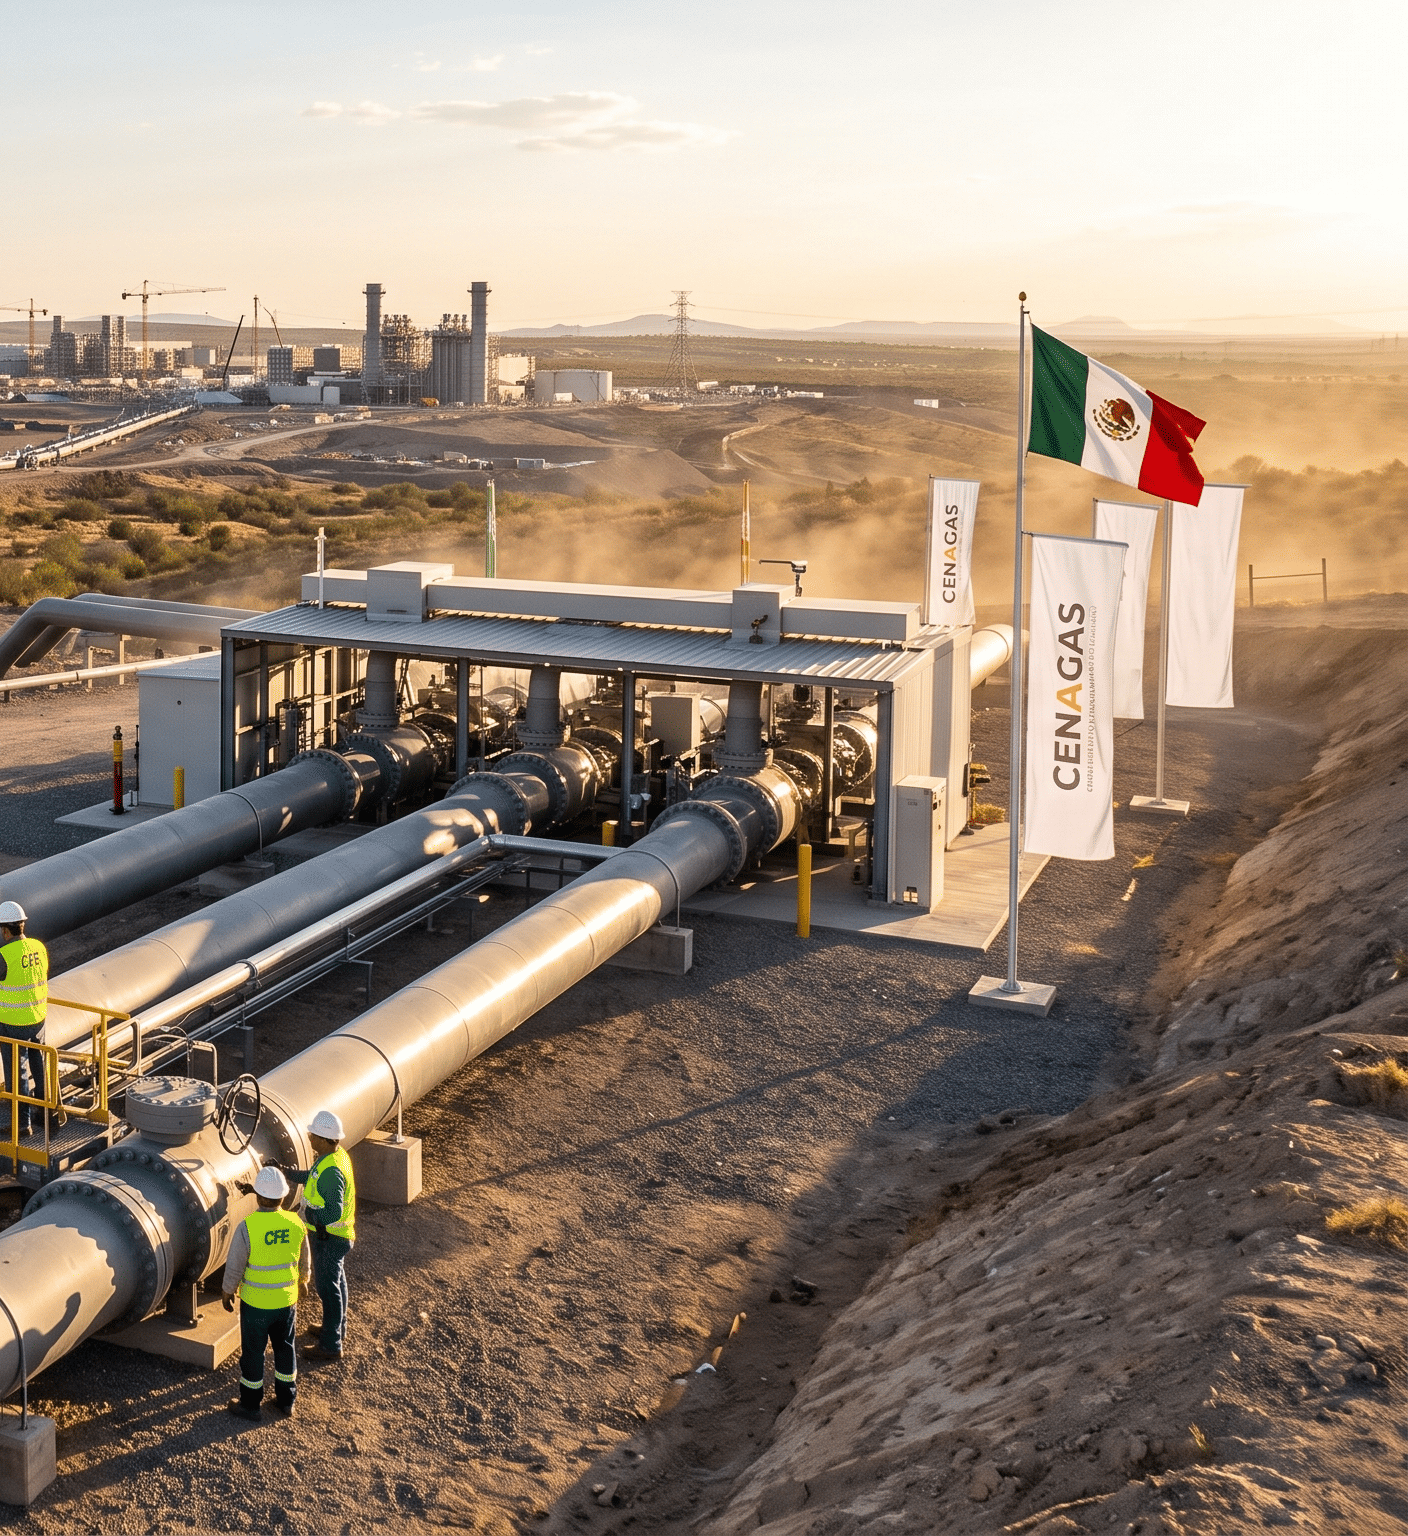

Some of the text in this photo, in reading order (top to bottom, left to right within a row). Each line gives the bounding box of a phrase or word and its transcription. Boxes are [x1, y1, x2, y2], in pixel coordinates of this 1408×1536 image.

[942, 504, 959, 604] CENAGAS
[1052, 602, 1086, 791] CENAGAS
[264, 1228, 290, 1246] CFE
